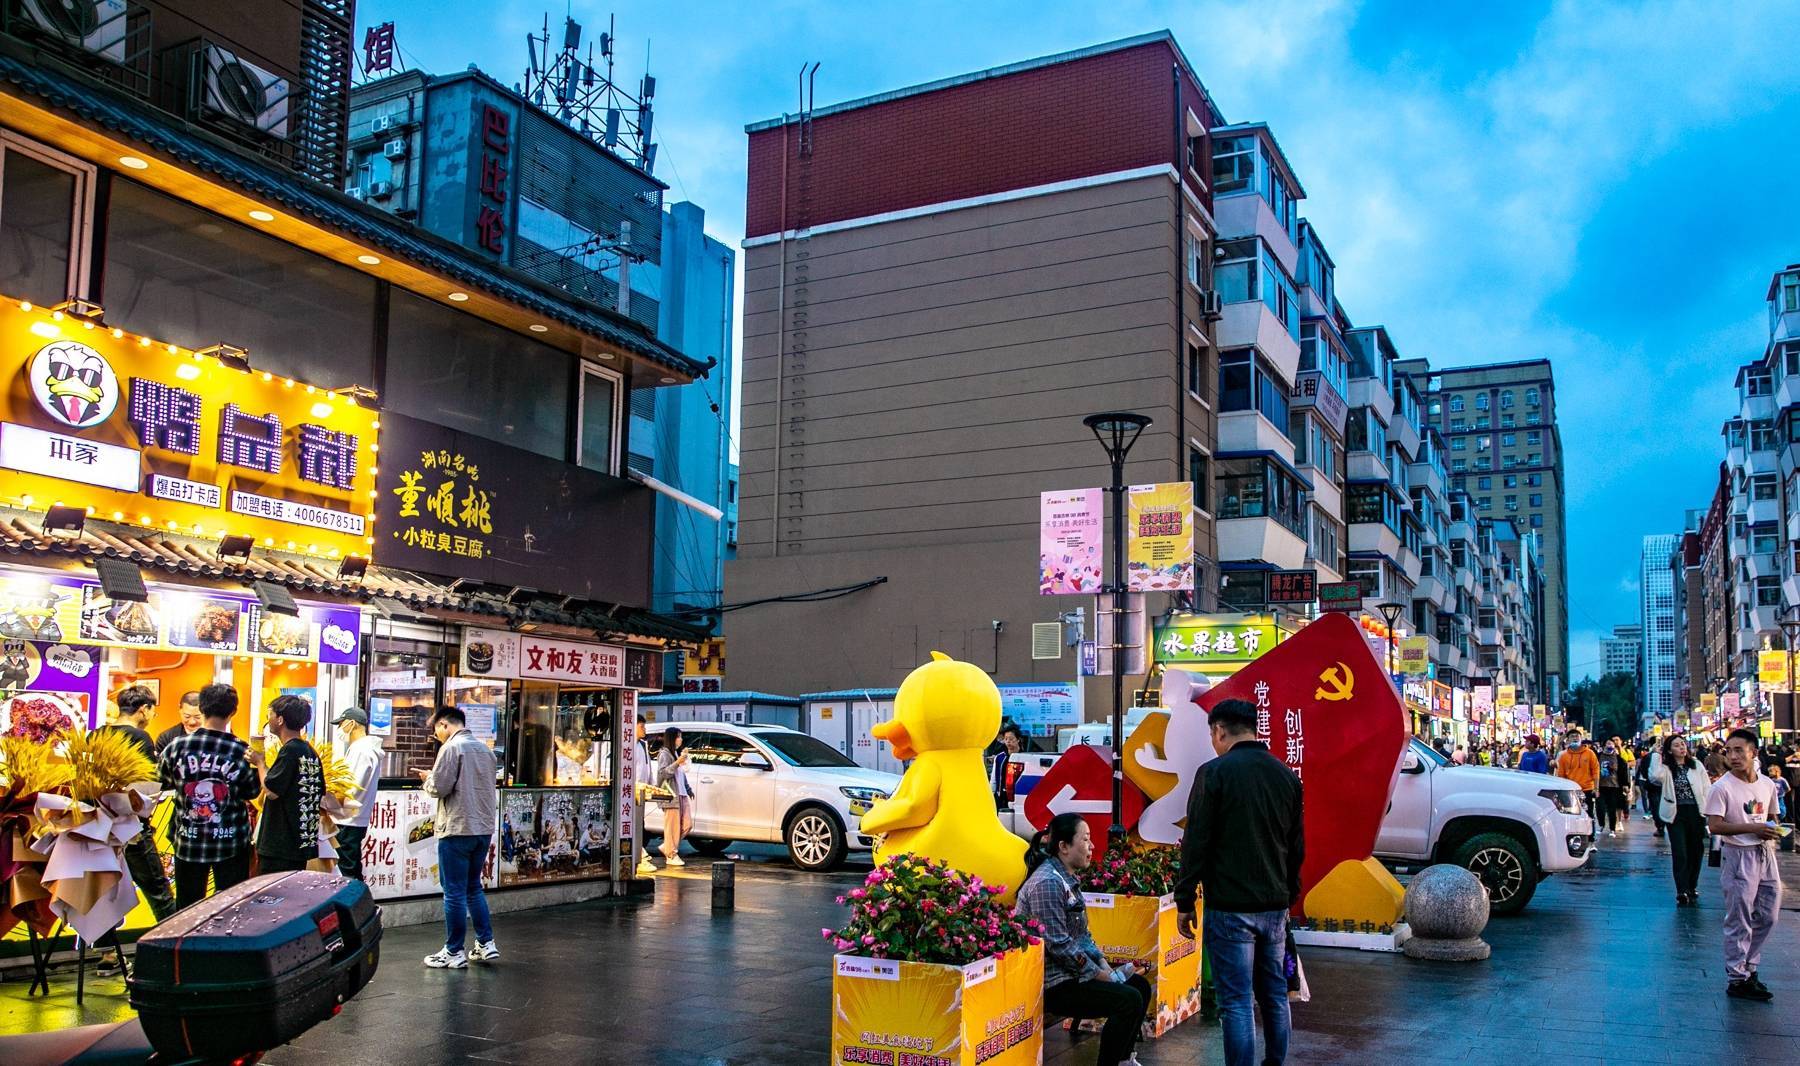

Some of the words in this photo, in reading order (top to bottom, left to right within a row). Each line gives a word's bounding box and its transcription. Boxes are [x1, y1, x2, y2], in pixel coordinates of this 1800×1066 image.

[363, 21, 394, 74] 馆
[477, 104, 509, 253] 巴比伦
[1291, 378, 1316, 397] 出租
[421, 450, 480, 481] 湖南名吃
[156, 477, 218, 506] 爆品打卡店
[1163, 627, 1263, 656] 水果超市
[527, 645, 583, 674] 文和友
[590, 652, 618, 666] 臭豆腐
[590, 666, 618, 678] 大香肠
[621, 709, 633, 835] 最好吃的烤冷面
[361, 835, 396, 867] 名吃
[843, 1046, 895, 1066] 乐享消费
